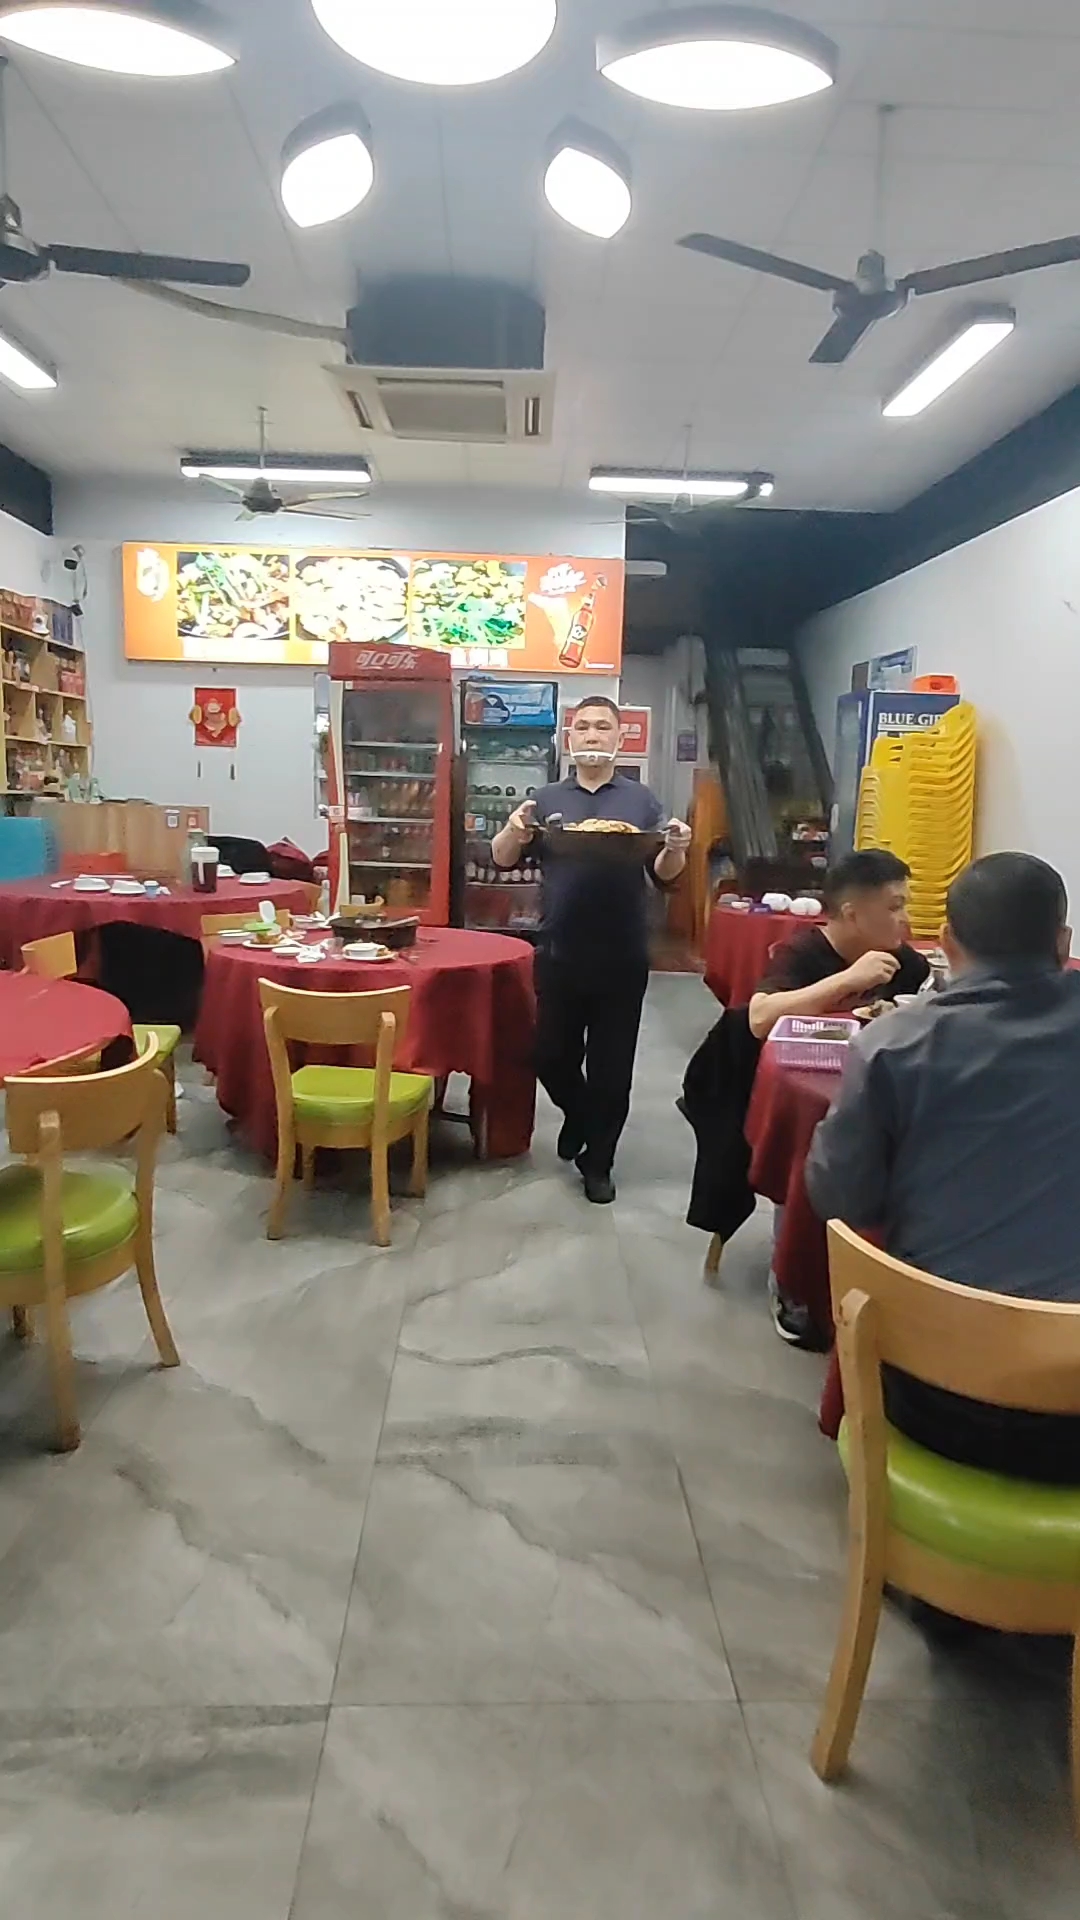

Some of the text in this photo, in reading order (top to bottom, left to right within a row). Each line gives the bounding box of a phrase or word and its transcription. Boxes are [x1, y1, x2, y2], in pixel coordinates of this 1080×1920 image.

[356, 650, 419, 670] 可口可乐
[878, 713, 914, 725] BLUE
